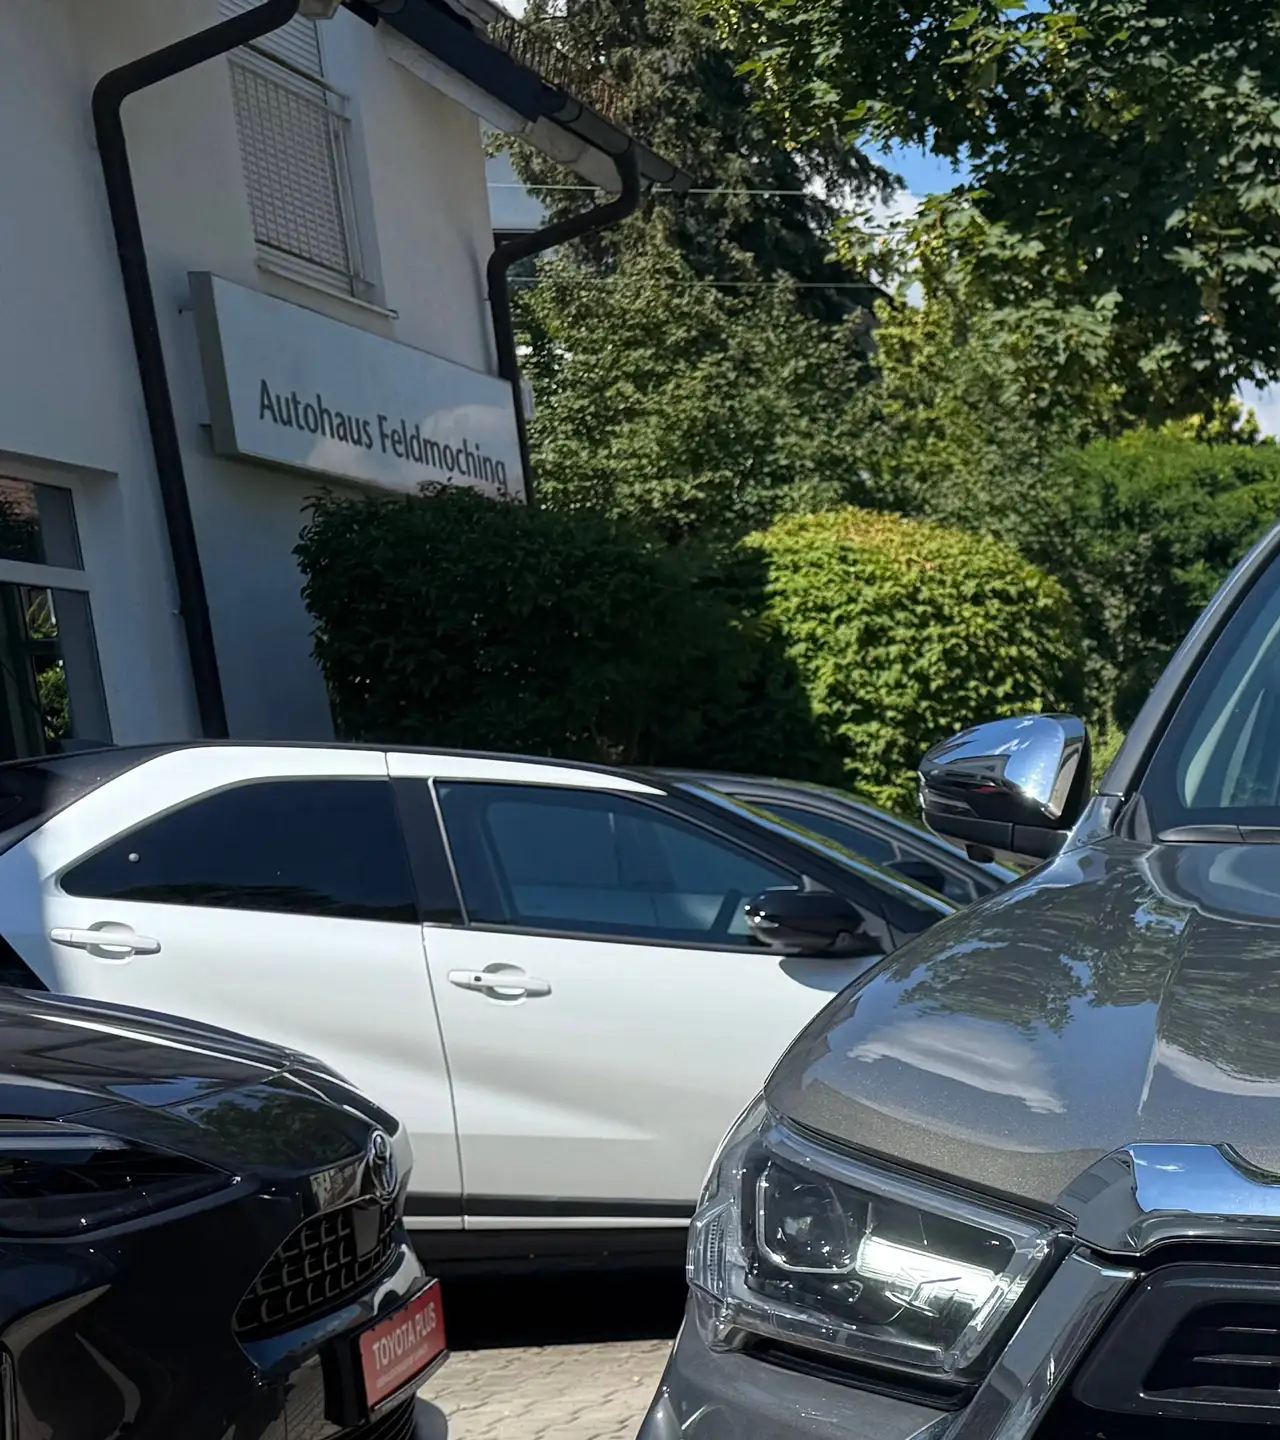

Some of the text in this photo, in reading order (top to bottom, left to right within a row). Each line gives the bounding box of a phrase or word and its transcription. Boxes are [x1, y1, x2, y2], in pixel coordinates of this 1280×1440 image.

[259, 378, 508, 492] Autohaus Feldmoching
[372, 1319, 416, 1371] TOYOTA
[415, 1302, 437, 1342] PLUS
